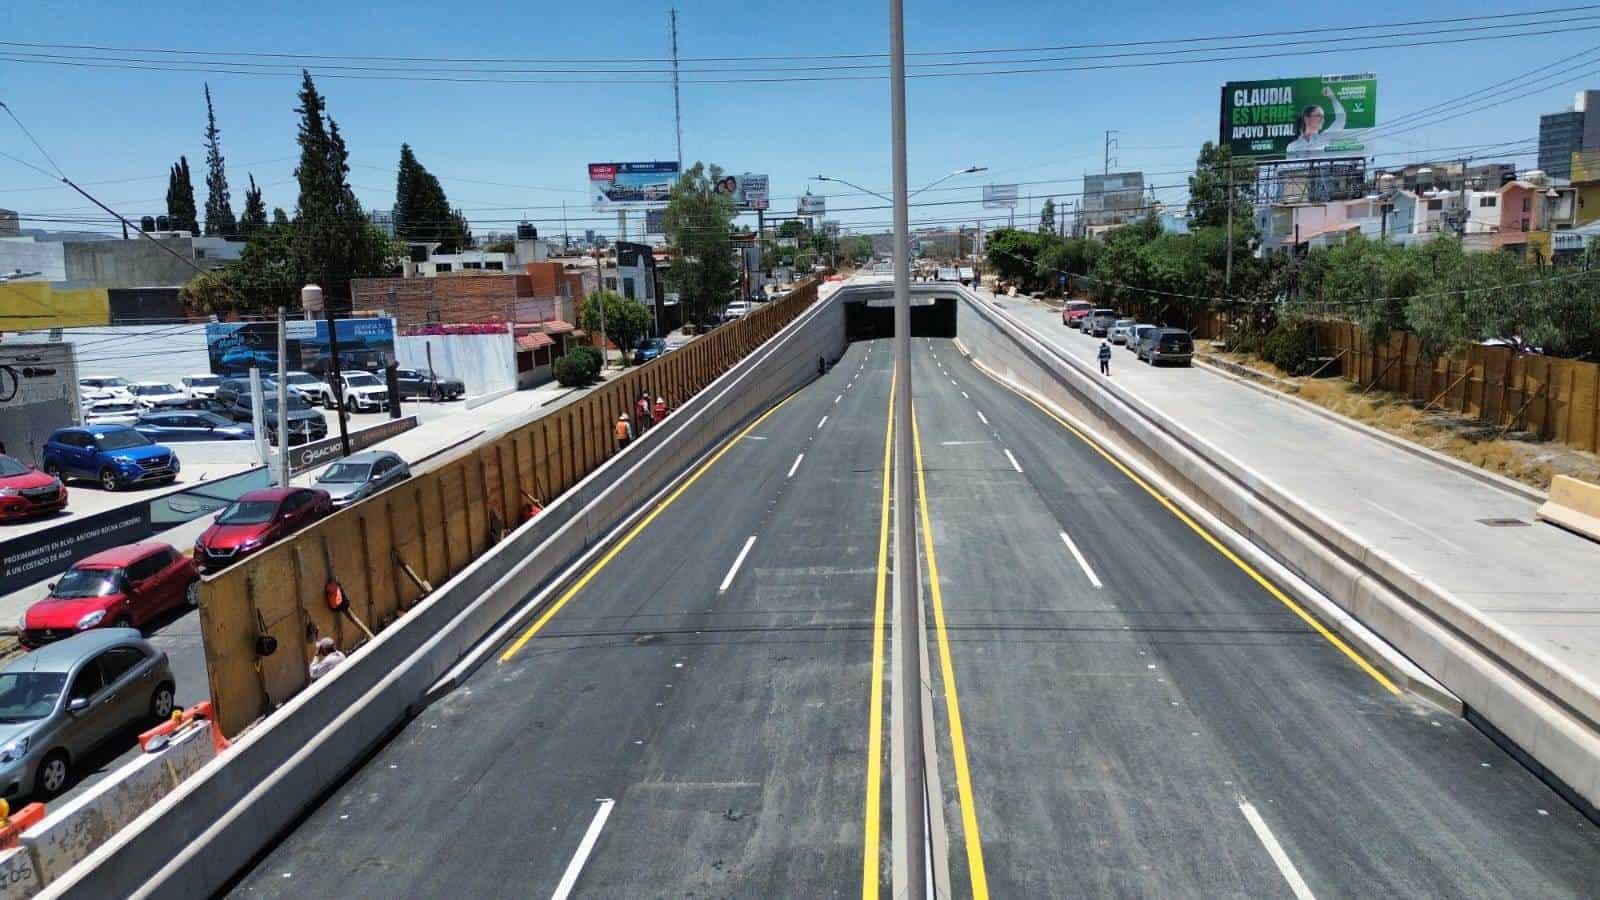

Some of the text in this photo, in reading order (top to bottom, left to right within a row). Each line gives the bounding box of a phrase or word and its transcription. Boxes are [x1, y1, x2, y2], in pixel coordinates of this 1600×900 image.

[1233, 86, 1293, 107] CLAUDIA
[1232, 105, 1297, 125] ES VERDE
[1232, 123, 1297, 139] APOYO TOTAL
[51, 542, 59, 551] EN
[11, 566, 21, 575] UN
[22, 556, 49, 571] COSTADO
